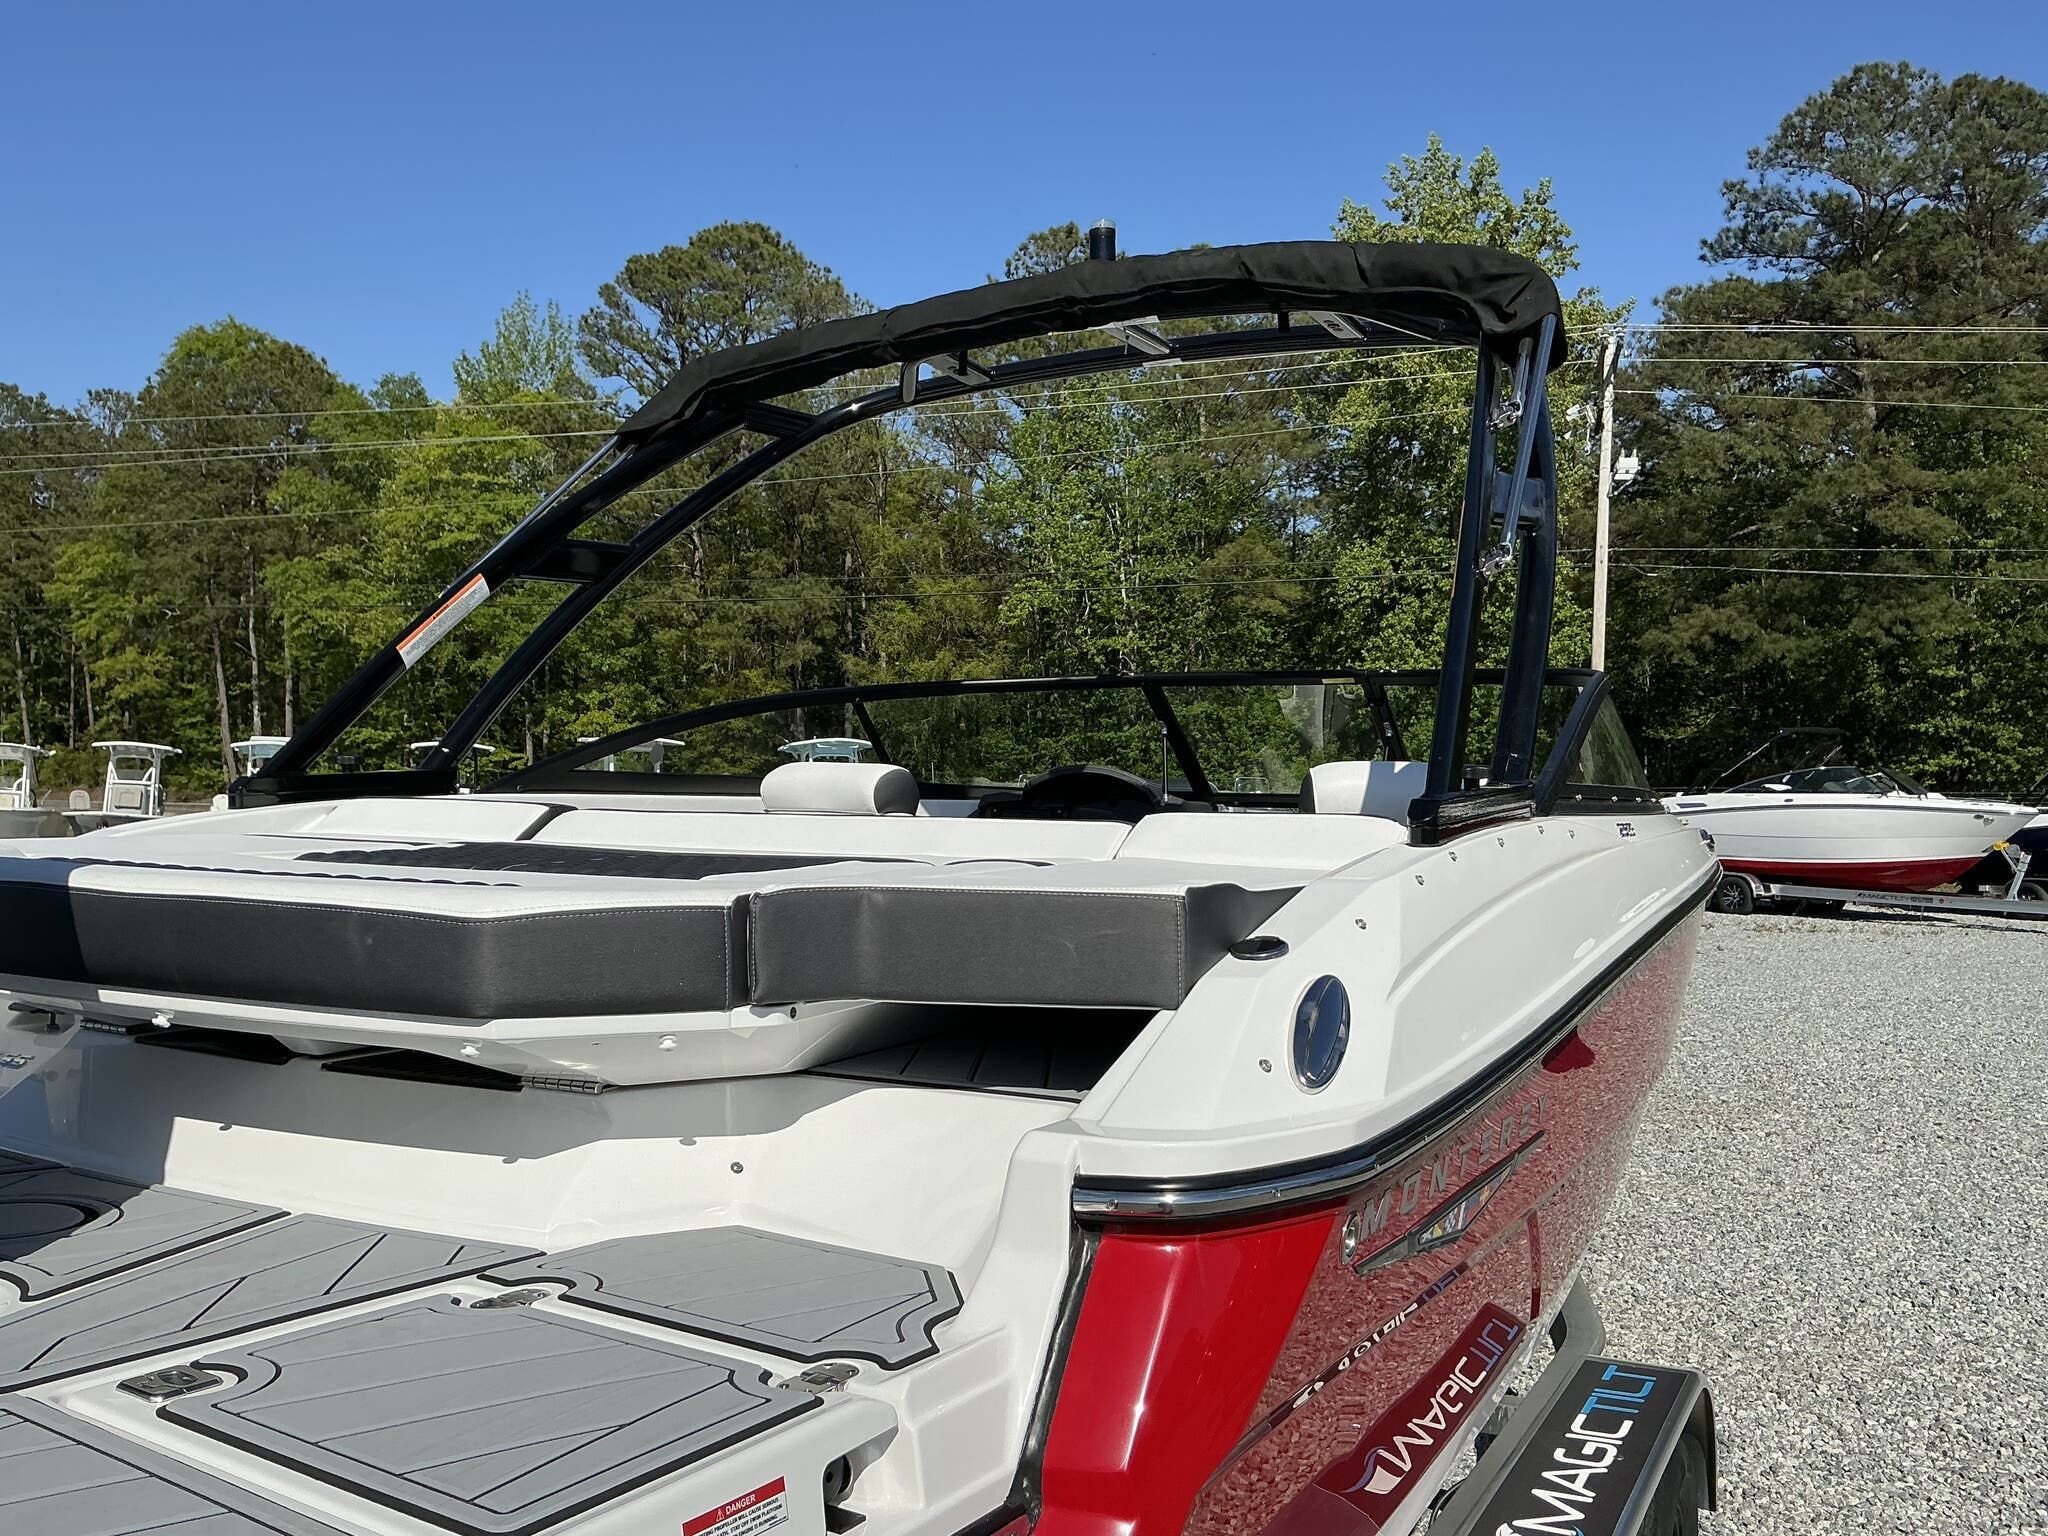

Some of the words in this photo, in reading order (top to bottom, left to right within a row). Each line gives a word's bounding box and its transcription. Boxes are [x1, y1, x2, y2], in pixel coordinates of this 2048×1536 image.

[1360, 1091, 1550, 1243] MONTEREY
[725, 1494, 756, 1515] DANGER
[1511, 1364, 1657, 1536] MAGICTILT
